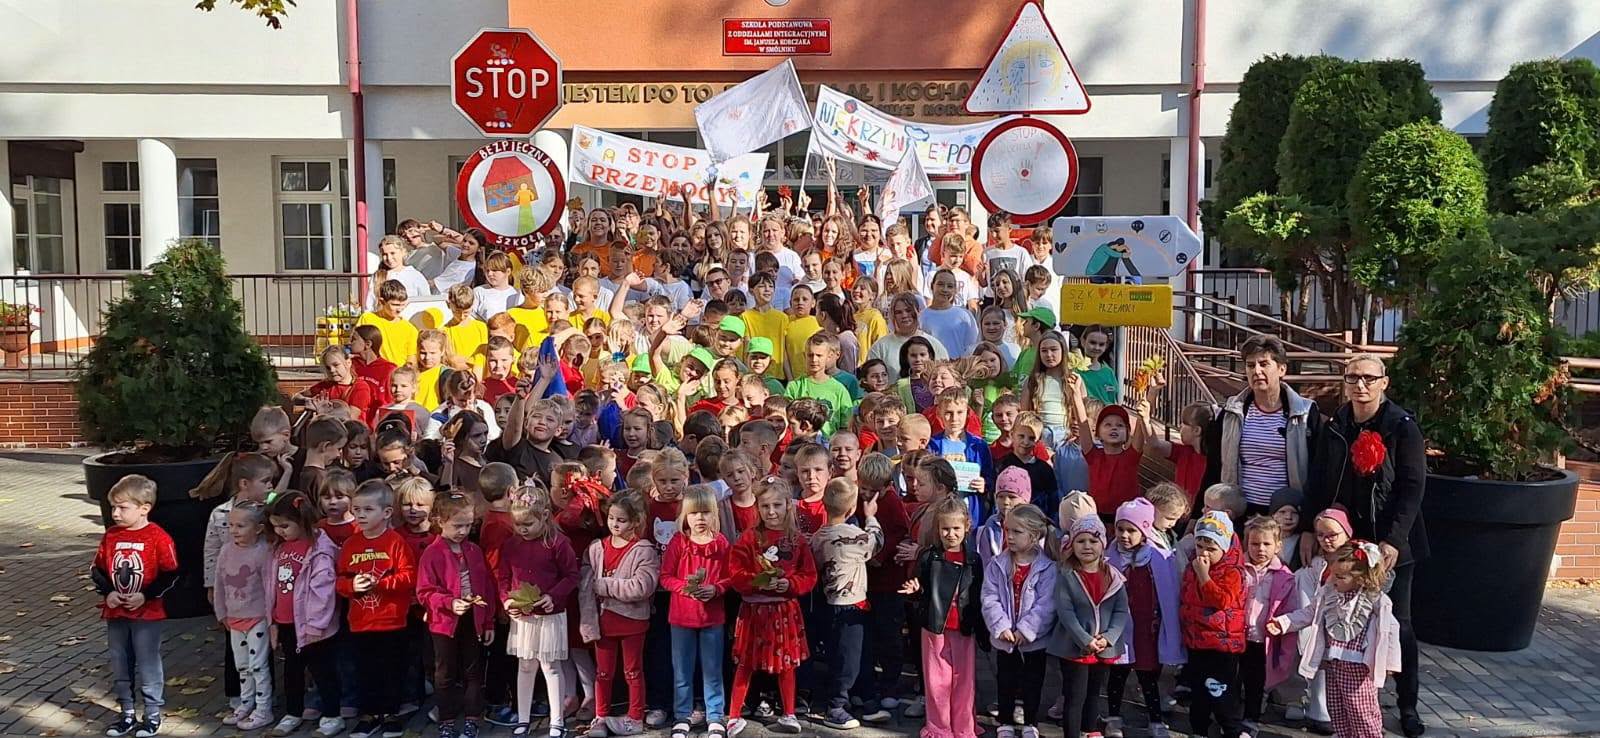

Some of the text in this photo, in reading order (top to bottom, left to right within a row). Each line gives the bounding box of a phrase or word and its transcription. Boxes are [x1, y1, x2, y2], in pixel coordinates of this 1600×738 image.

[773, 30, 827, 38] INTEGRACYJNYMI
[465, 66, 550, 99] STOP
[563, 84, 640, 104] JESTEM
[644, 84, 678, 104] PO
[891, 82, 970, 102] KOCHA
[479, 140, 552, 167] BEZPIECZNA
[627, 147, 698, 171] STOP
[591, 164, 734, 203] PRZEMOCY
[495, 231, 545, 247] SZKOŁA
